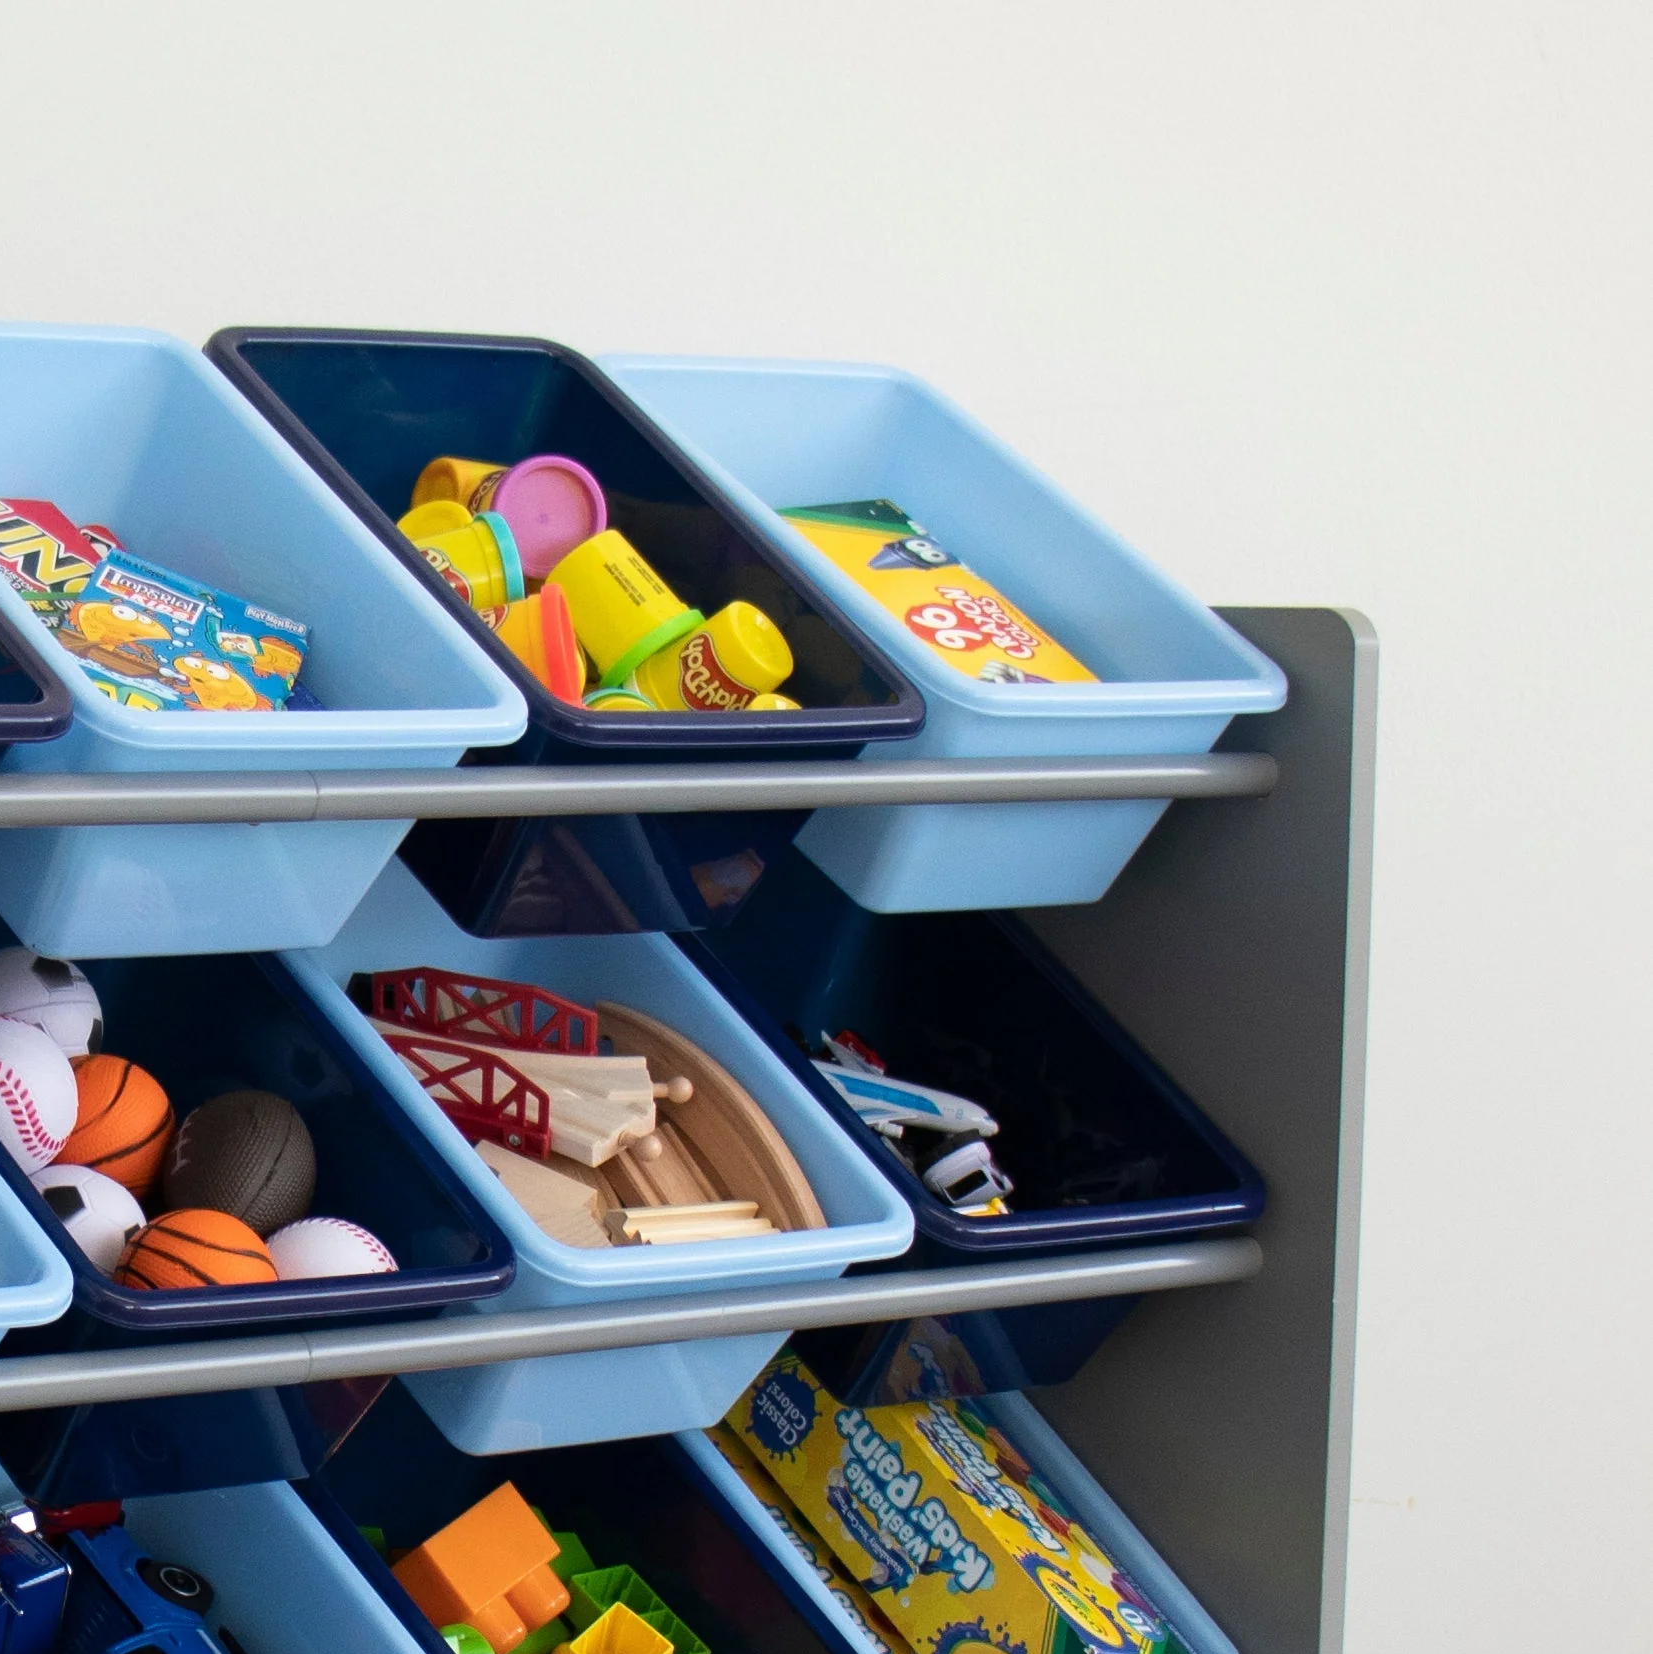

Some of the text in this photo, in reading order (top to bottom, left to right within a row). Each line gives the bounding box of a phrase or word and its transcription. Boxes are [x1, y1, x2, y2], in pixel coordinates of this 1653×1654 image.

[27, 600, 55, 612] HE
[130, 592, 189, 621] KIDS
[910, 606, 983, 651] 96
[937, 586, 1034, 660] CRAYON
[975, 595, 1041, 648] COLORS
[756, 1393, 797, 1446] Classic
[766, 1380, 806, 1432] Colors!
[837, 1406, 920, 1509] Paint
[846, 1460, 929, 1565] Washable
[870, 1542, 904, 1576] Washability
[1120, 1606, 1153, 1636] 10
